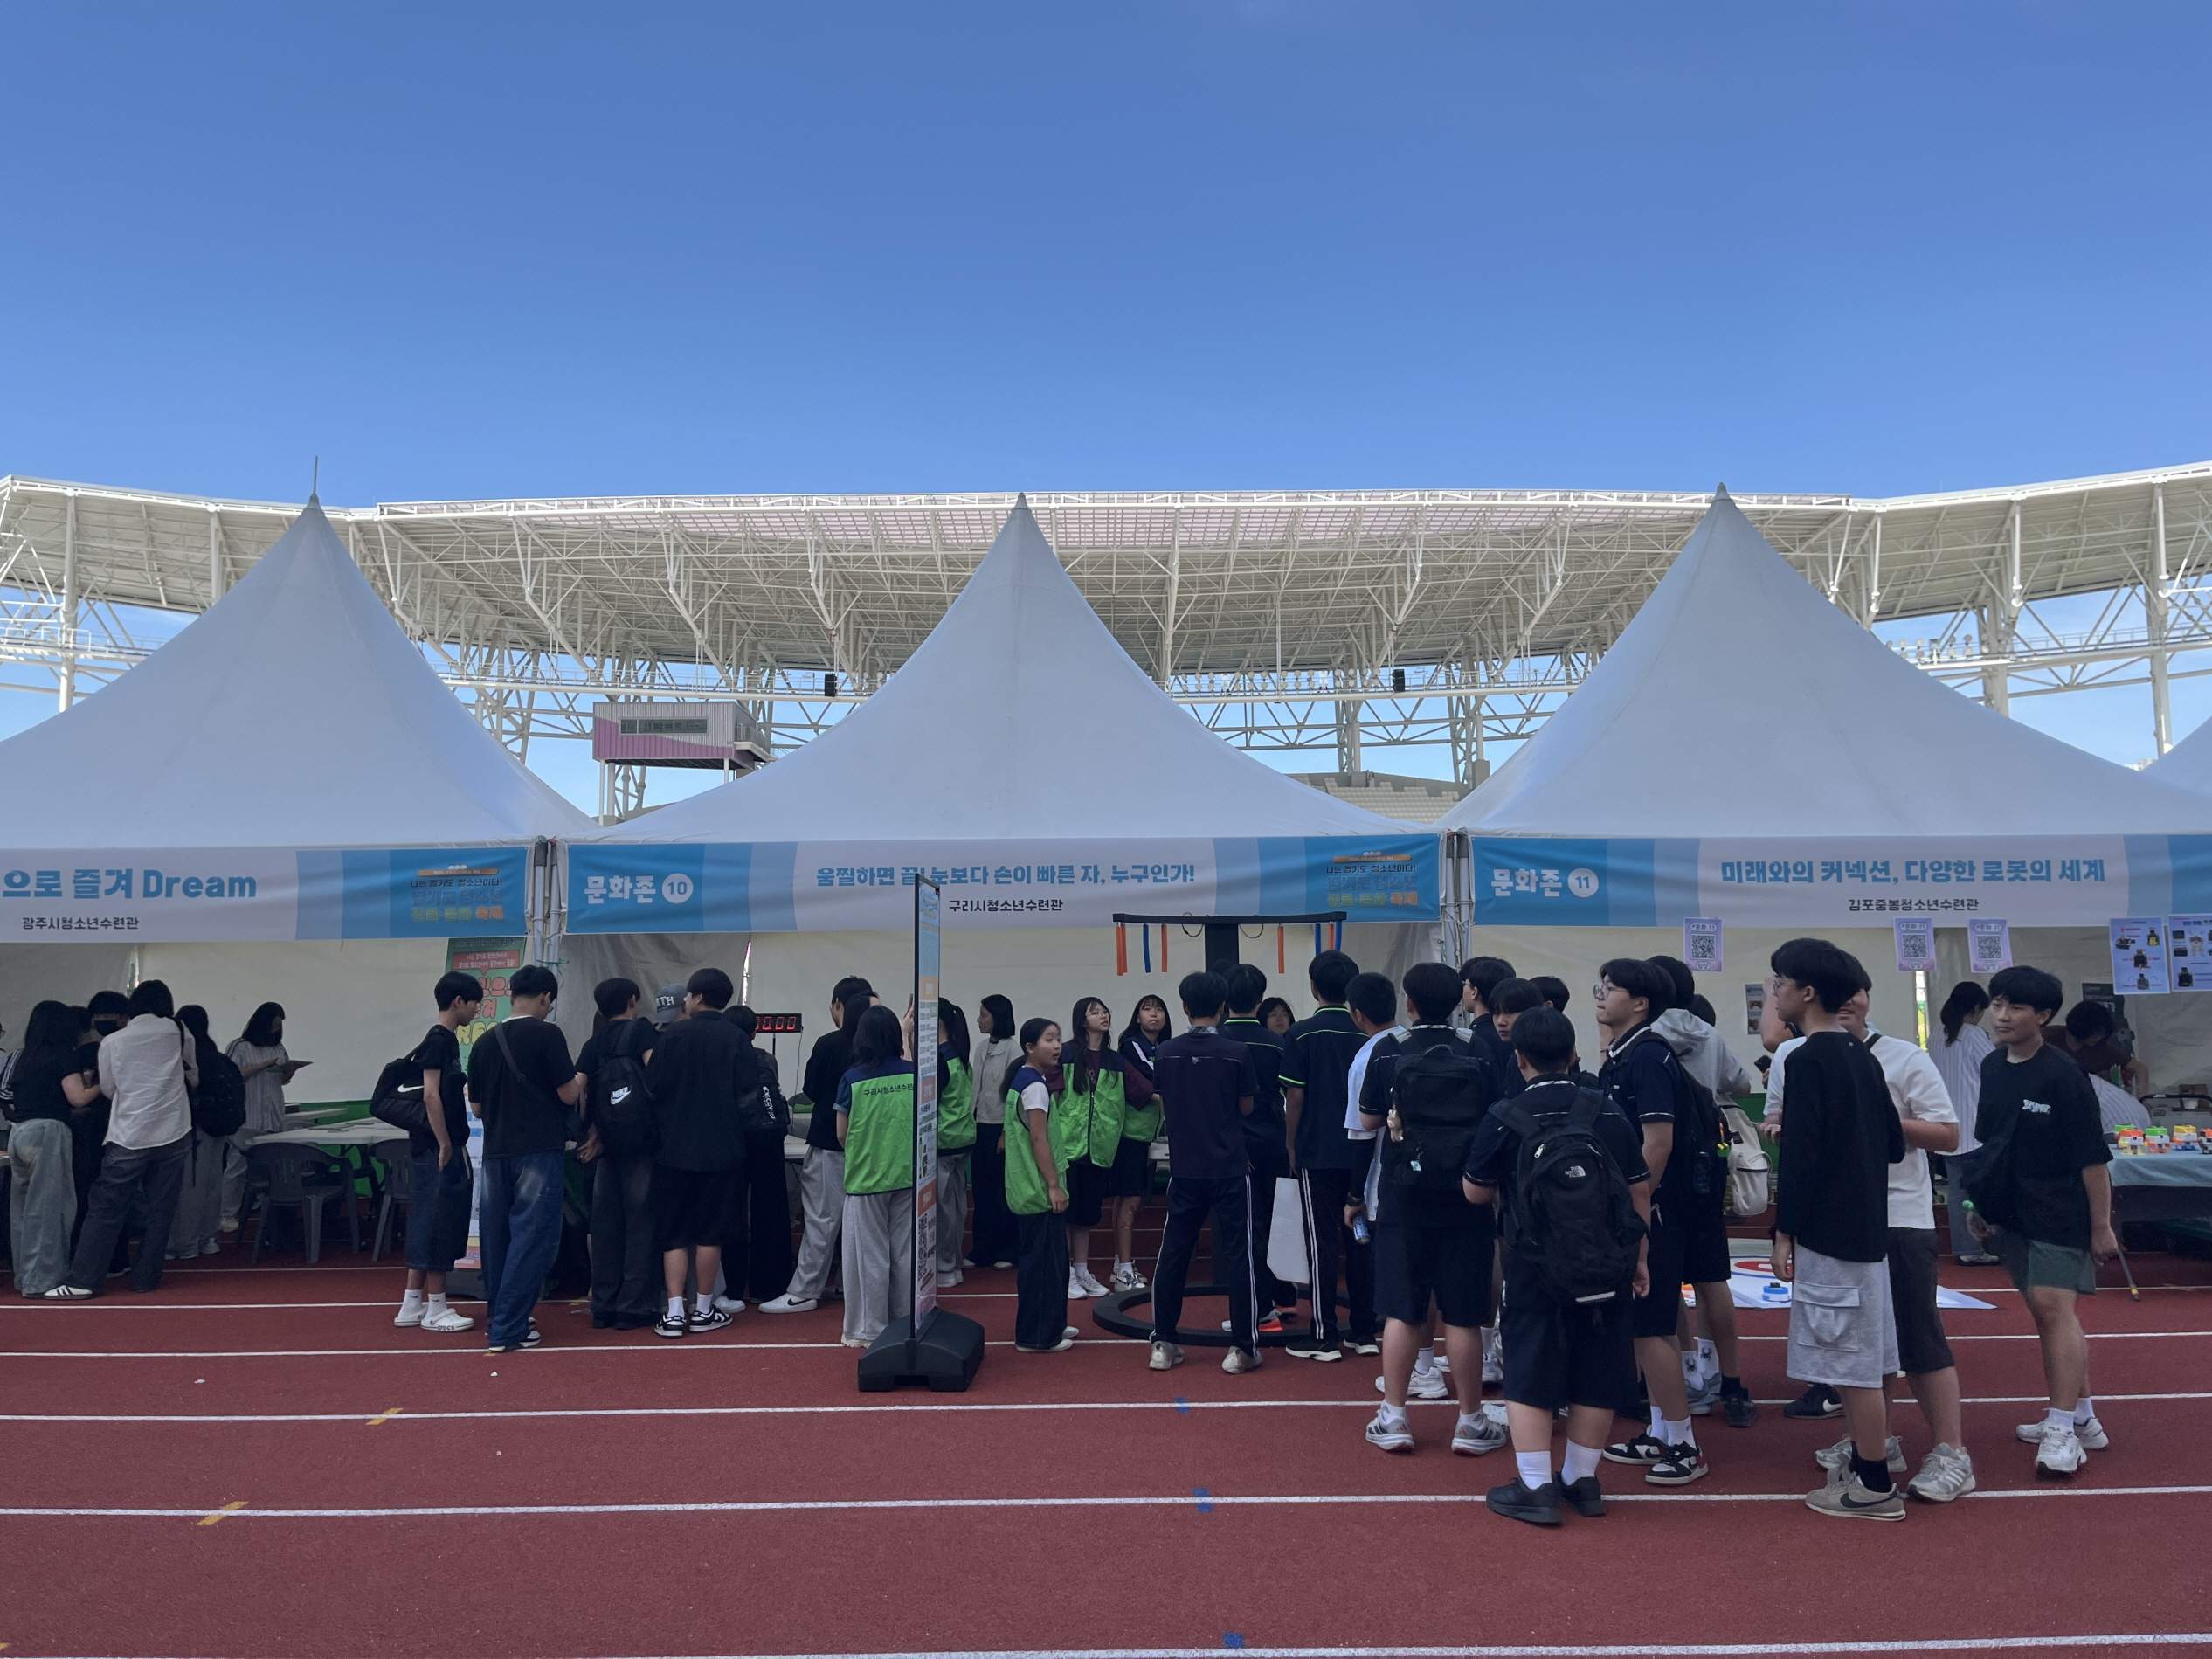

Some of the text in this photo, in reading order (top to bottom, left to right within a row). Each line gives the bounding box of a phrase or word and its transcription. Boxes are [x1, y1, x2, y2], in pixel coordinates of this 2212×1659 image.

[816, 866, 895, 887] 움찔하면
[930, 866, 989, 885] 눈보다
[993, 865, 1032, 885] 손이
[1036, 865, 1075, 885] 빠른
[1080, 864, 1106, 886] 자,
[1110, 864, 1196, 884] 누구인가!
[1344, 865, 1368, 874] 경기도
[1371, 863, 1417, 873] 청소년이다!
[1721, 859, 2105, 885] 미래와의 커넥션, 다양한 로봇의 세계
[2, 868, 258, 900] 으로 즐겨 Dream
[429, 879, 454, 888] 경기도
[458, 878, 503, 887] 청소년이다!
[584, 875, 688, 904] 문화존 10
[1490, 868, 1591, 897] 문화존 11
[949, 899, 1063, 912] 구리시청소년수련관
[1848, 898, 1980, 911] 김포중봉청소년수련관
[22, 917, 140, 930] 광주시청소년수련관
